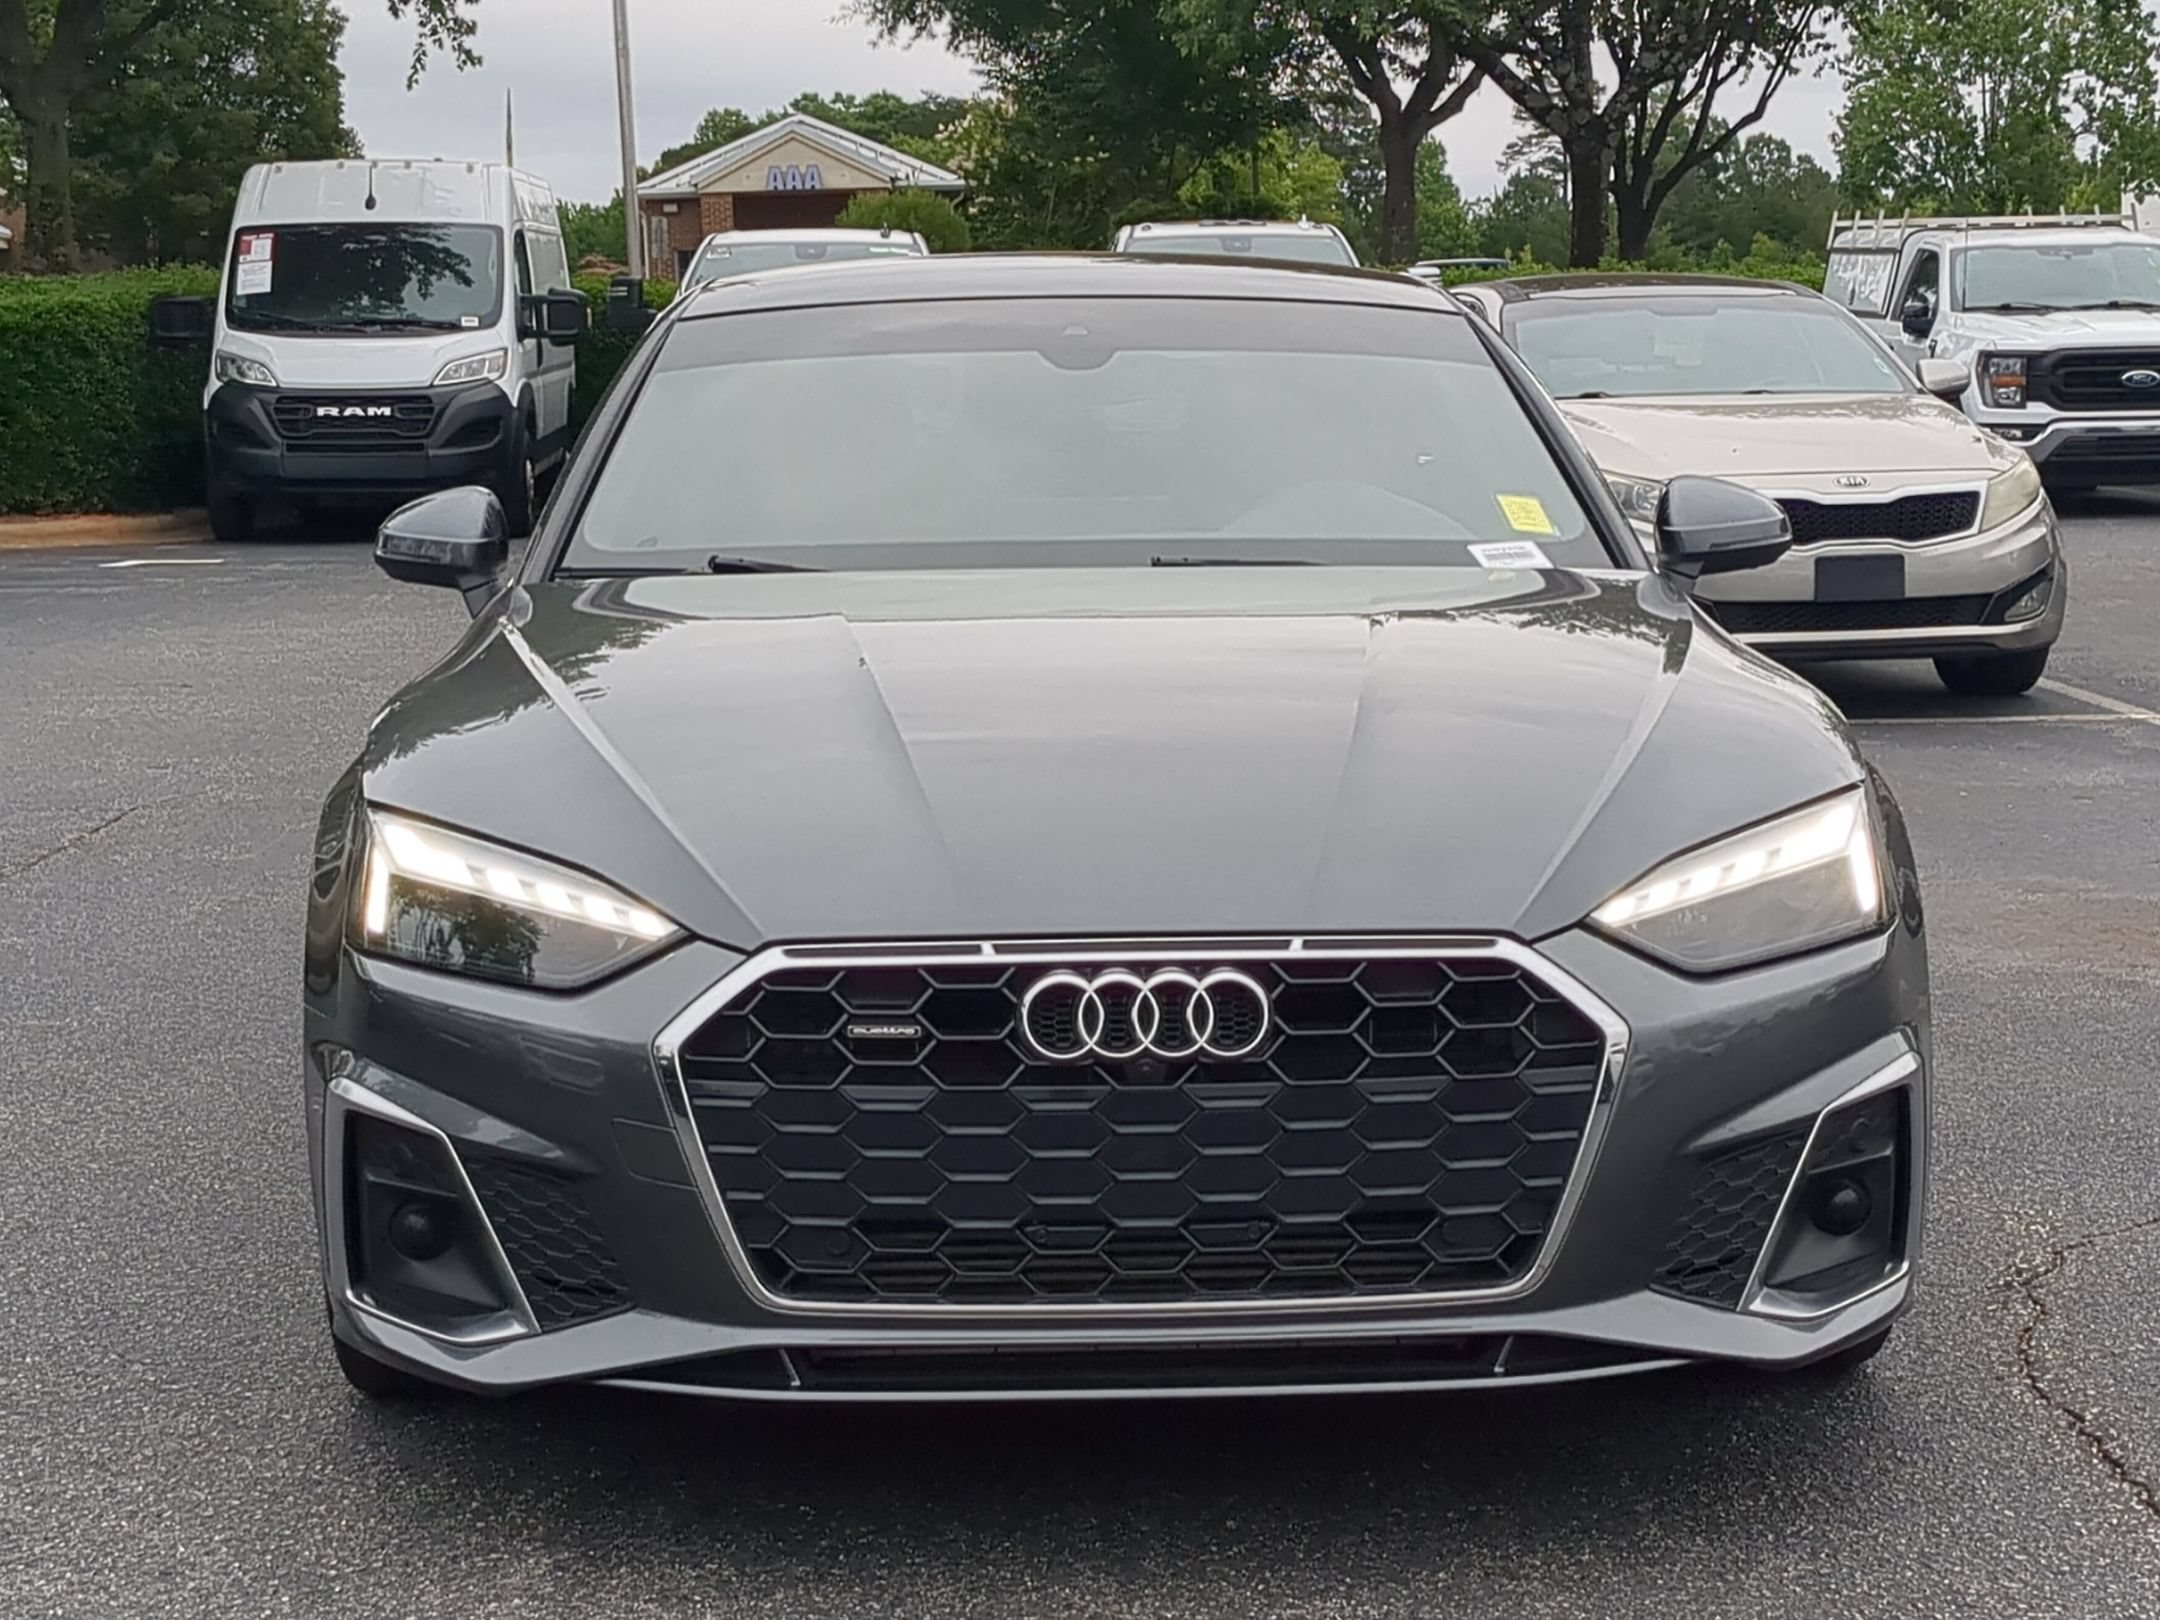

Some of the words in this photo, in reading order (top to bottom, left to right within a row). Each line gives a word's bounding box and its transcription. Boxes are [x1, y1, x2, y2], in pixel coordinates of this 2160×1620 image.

[767, 165, 823, 190] AAA
[316, 406, 392, 417] RAM
[1838, 475, 1868, 487] KIA
